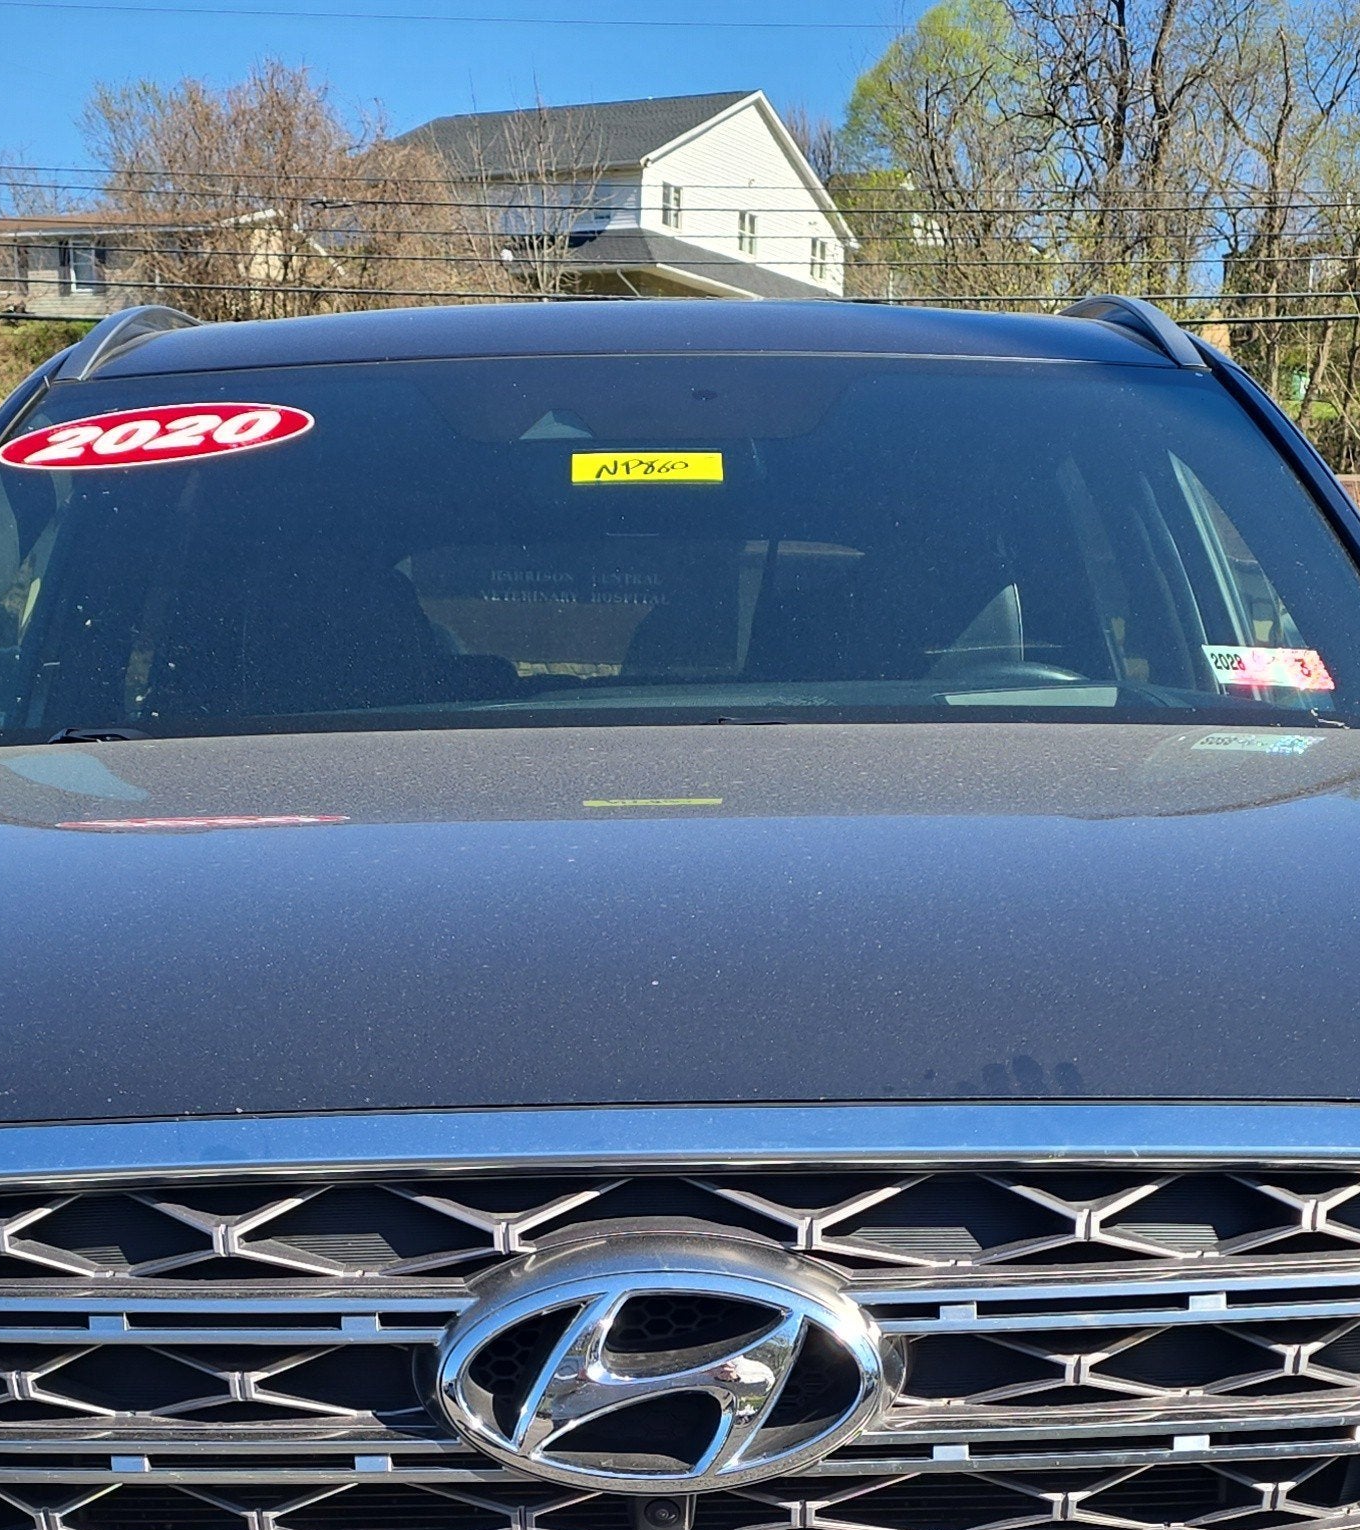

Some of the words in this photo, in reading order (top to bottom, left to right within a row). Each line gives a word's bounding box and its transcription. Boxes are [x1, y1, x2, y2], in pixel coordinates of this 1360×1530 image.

[24, 410, 283, 464] 2020
[595, 459, 689, 479] NP860
[490, 570, 574, 582] HARRISON
[480, 589, 577, 603] VETERINARY
[591, 591, 670, 605] HOSPITAL
[1210, 653, 1246, 671] 2028
